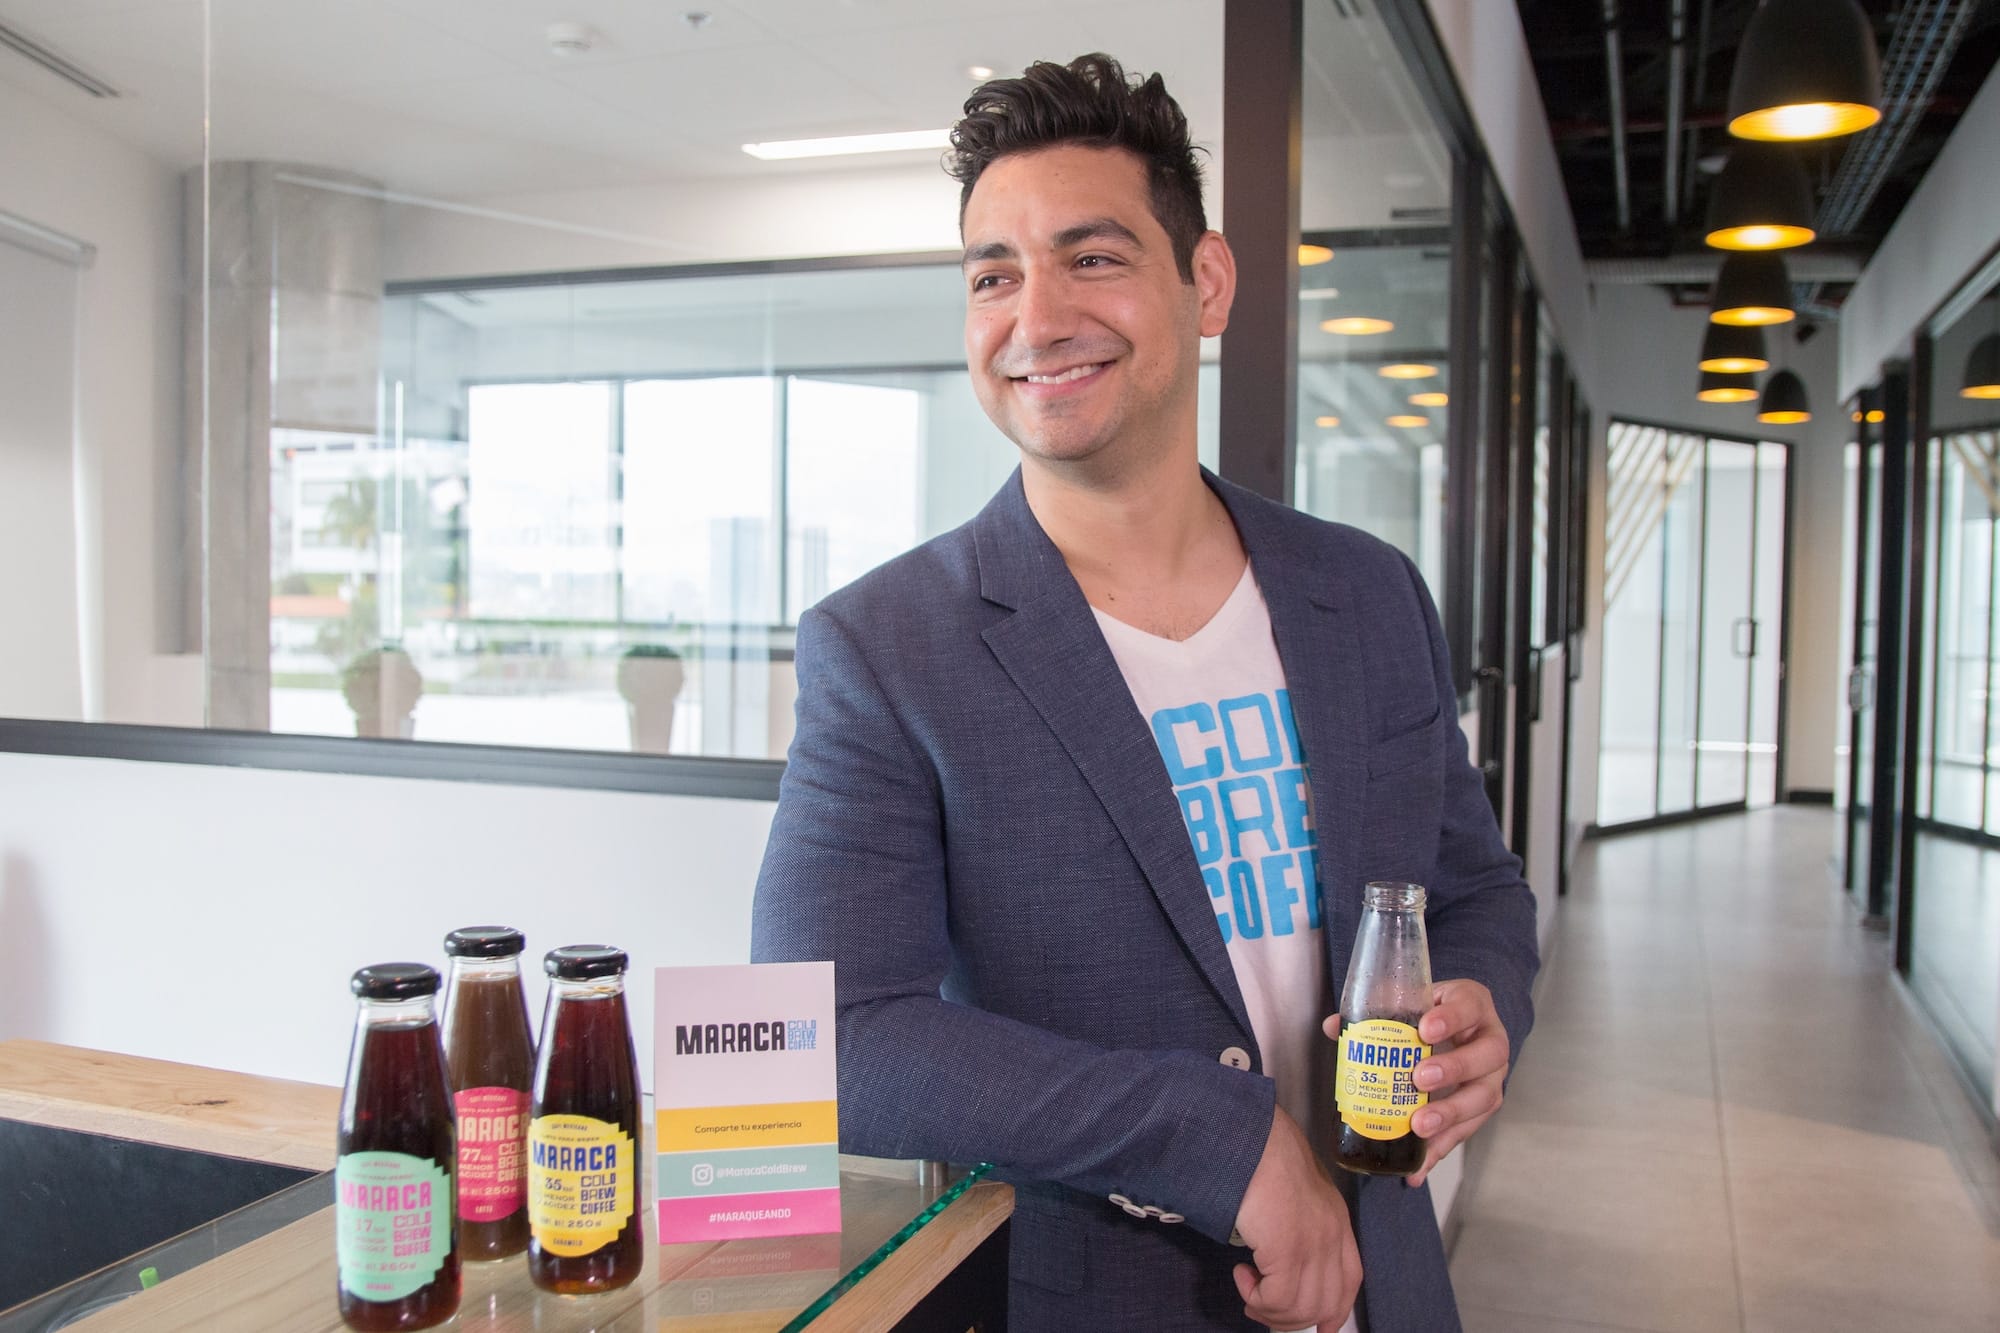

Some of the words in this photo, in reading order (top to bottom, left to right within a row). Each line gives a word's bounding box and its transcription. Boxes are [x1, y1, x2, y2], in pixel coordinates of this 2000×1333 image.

[1152, 689, 1309, 786] CO
[1176, 768, 1318, 866] BRE
[788, 1019, 816, 1030] COLD
[676, 1021, 785, 1055] MARACA
[788, 1030, 816, 1040] BREW
[788, 1040, 816, 1050] COFFEE
[1348, 1039, 1422, 1068] MARACA
[1361, 1071, 1378, 1084] 35
[1359, 1084, 1388, 1093] MENOR
[1392, 1094, 1418, 1105] COFFEE
[695, 1124, 739, 1134] Comparte
[741, 1123, 750, 1131] tu
[752, 1121, 802, 1133] experiencia
[461, 1147, 481, 1161] 77
[533, 1139, 616, 1171] MARACA
[717, 1164, 807, 1178] @MaracaColdBrew
[581, 1172, 616, 1187] COLD
[341, 1179, 432, 1213] MARACA
[581, 1187, 616, 1201] BREW
[581, 1199, 616, 1215] COFFEE
[393, 1211, 432, 1229] COLD
[709, 1208, 792, 1223] #MARAQUEANDO
[393, 1226, 432, 1243] BREW
